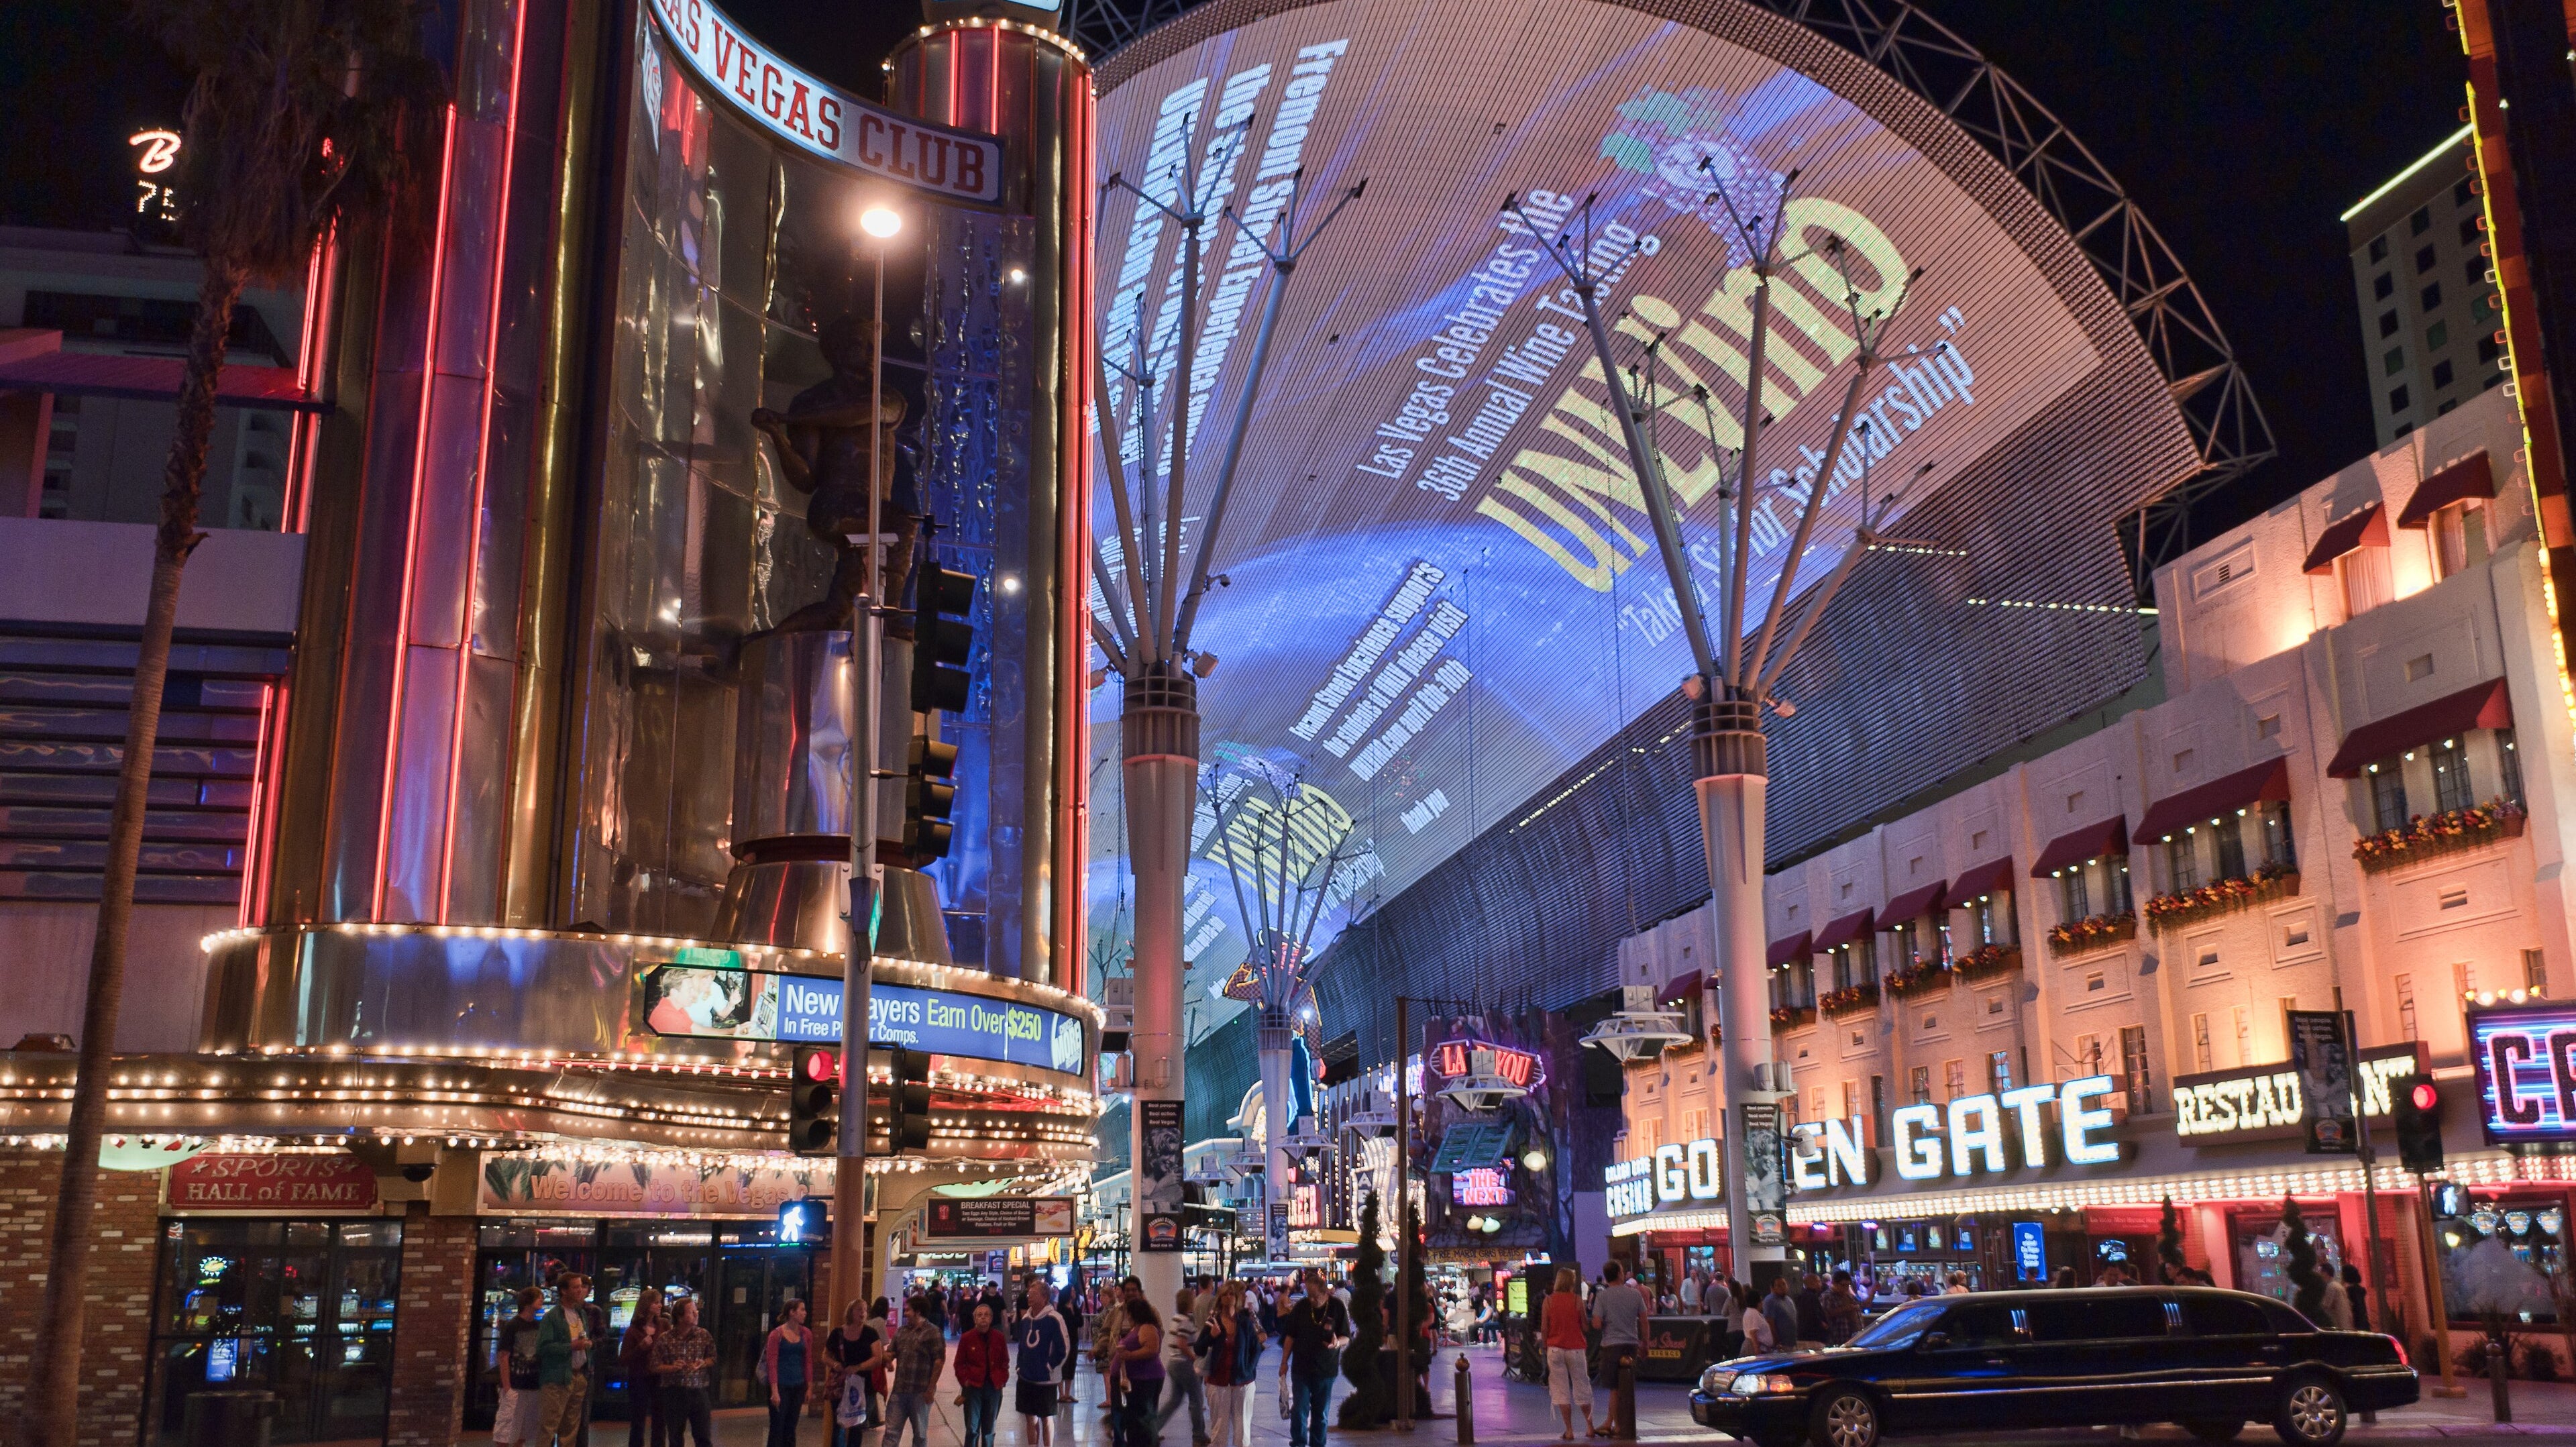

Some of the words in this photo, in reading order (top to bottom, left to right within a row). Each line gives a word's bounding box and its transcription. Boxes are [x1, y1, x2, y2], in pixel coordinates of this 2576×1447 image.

[655, 0, 701, 54] AS
[712, 17, 841, 151] VEGAS
[858, 113, 984, 194] CLUB
[1215, 63, 1272, 129] the
[1256, 38, 1349, 182] Fremont
[129, 130, 181, 173] B
[1225, 178, 1295, 270] Street
[1499, 189, 1574, 240] the
[1536, 220, 1660, 323] Tasting
[1190, 266, 1262, 397] Experience
[1415, 244, 1540, 378] Celebrates
[1493, 323, 1576, 386] Wine
[1377, 381, 1455, 441] Vegas
[1448, 379, 1533, 460] Annual
[1475, 197, 1911, 593] UNLVino
[1356, 444, 1413, 479] Las
[1417, 455, 1481, 501] 36th
[1289, 701, 1333, 741] Fremont
[1316, 675, 1353, 711] Street
[1336, 617, 1401, 686] Experience
[1384, 561, 1445, 624] supports
[1322, 730, 1350, 759] the
[1336, 699, 1383, 747] students
[1368, 686, 1389, 710] of
[1397, 631, 1445, 678] please
[1428, 599, 1469, 639] visit
[1399, 699, 1434, 733] april
[1400, 800, 1434, 835] thank
[1423, 788, 1450, 819] you
[784, 1017, 796, 1034] In
[800, 1018, 829, 1036] Free
[877, 1024, 919, 1045] Comps.
[786, 983, 840, 1016] New
[868, 997, 920, 1025] ayers
[927, 998, 966, 1030] Earn
[971, 1004, 1006, 1035] Over
[1008, 1006, 1042, 1041] $250
[1444, 1045, 1466, 1075] LA
[2174, 1055, 2414, 1136] RESTAUN
[211, 1158, 337, 1177] SPORTS
[1656, 1114, 1867, 1202] GOEN
[1892, 1075, 2119, 1180] GATE
[185, 1183, 252, 1201] HALL
[258, 1180, 284, 1200] of
[290, 1183, 360, 1201] FAME
[531, 1175, 643, 1201] Welcome
[649, 1181, 672, 1202] to
[682, 1180, 718, 1203] the
[724, 1181, 789, 1208] Vegas
[1464, 1187, 1508, 1205] NEXT
[1469, 1174, 1500, 1187] THE
[1606, 1177, 1652, 1218] CASINO
[1434, 1251, 1450, 1259] FREE
